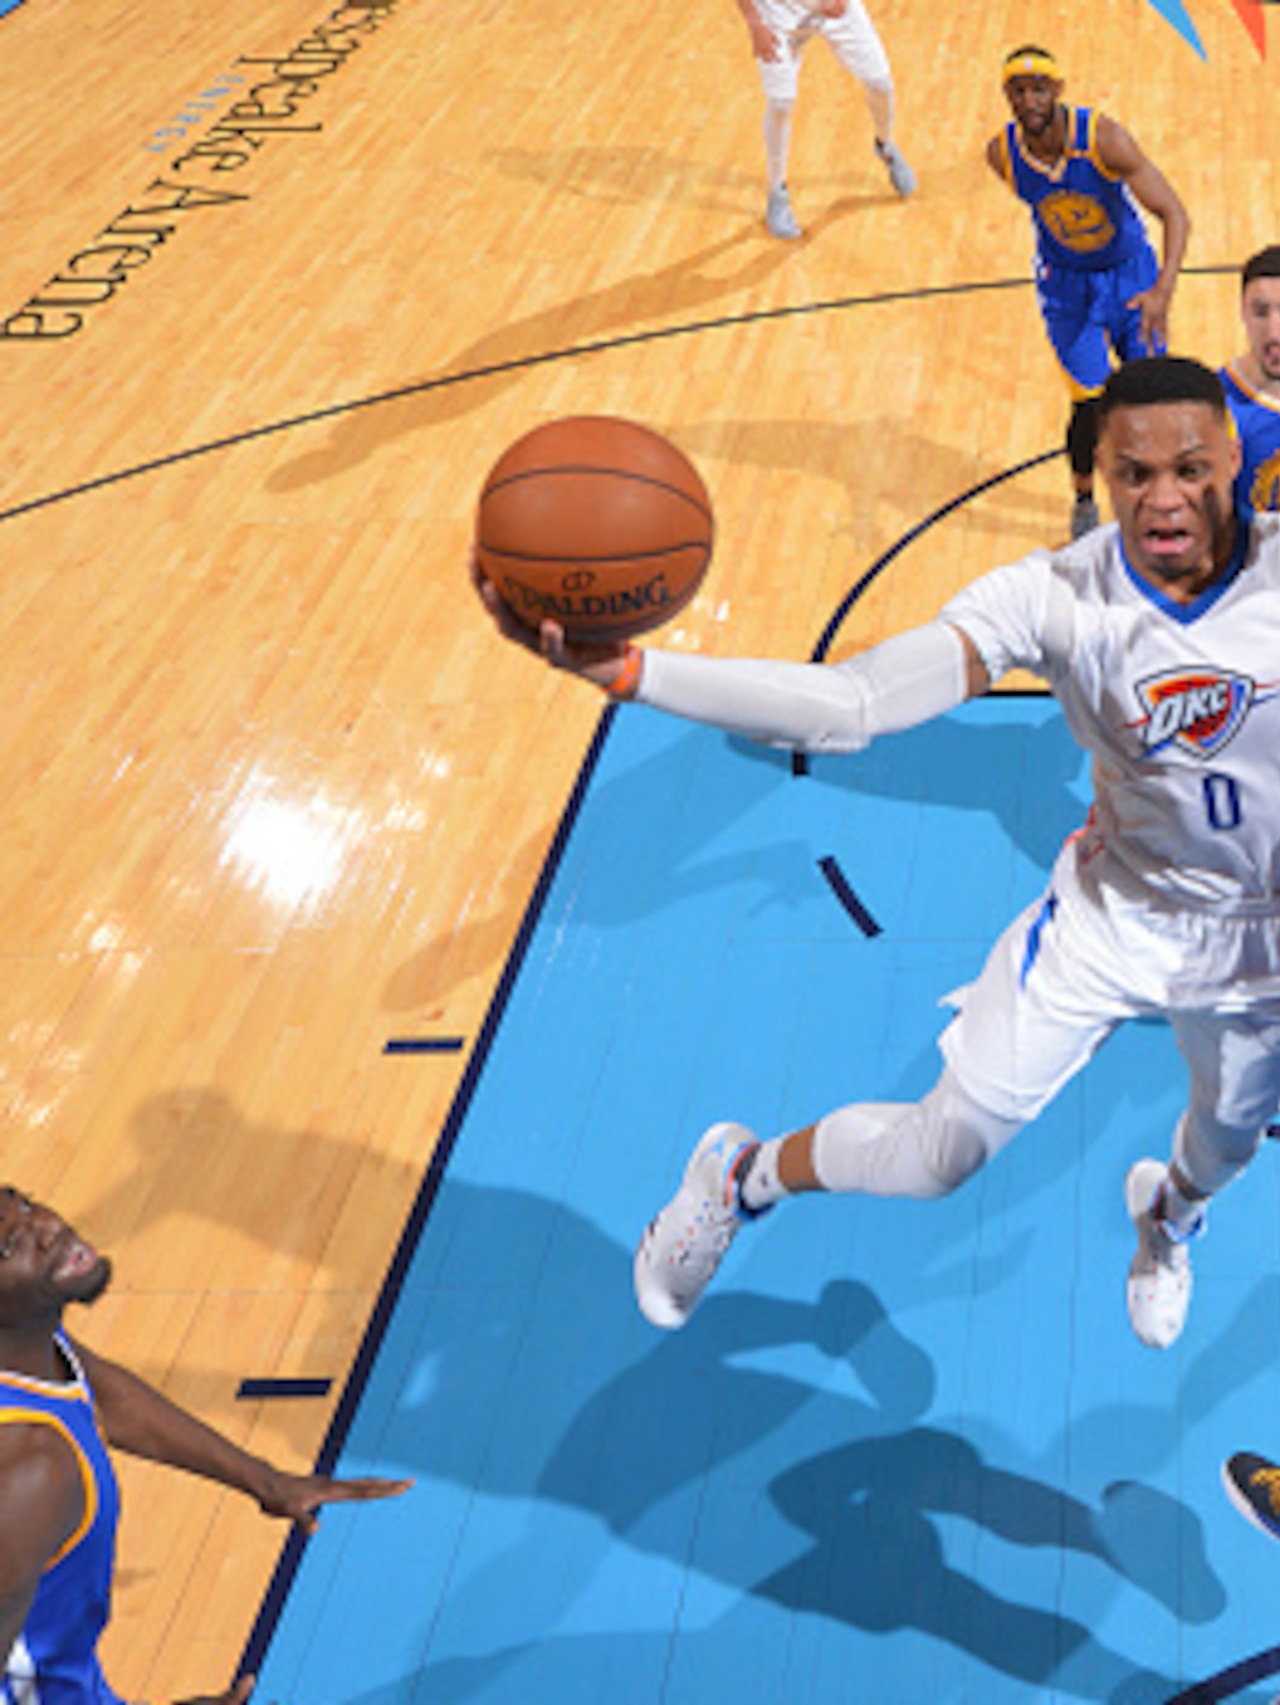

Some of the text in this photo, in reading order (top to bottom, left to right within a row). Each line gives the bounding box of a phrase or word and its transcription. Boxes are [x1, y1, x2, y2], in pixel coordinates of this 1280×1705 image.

[0, 178, 250, 339] Arena
[1147, 681, 1229, 747] OKC
[1203, 772, 1242, 832] 0
